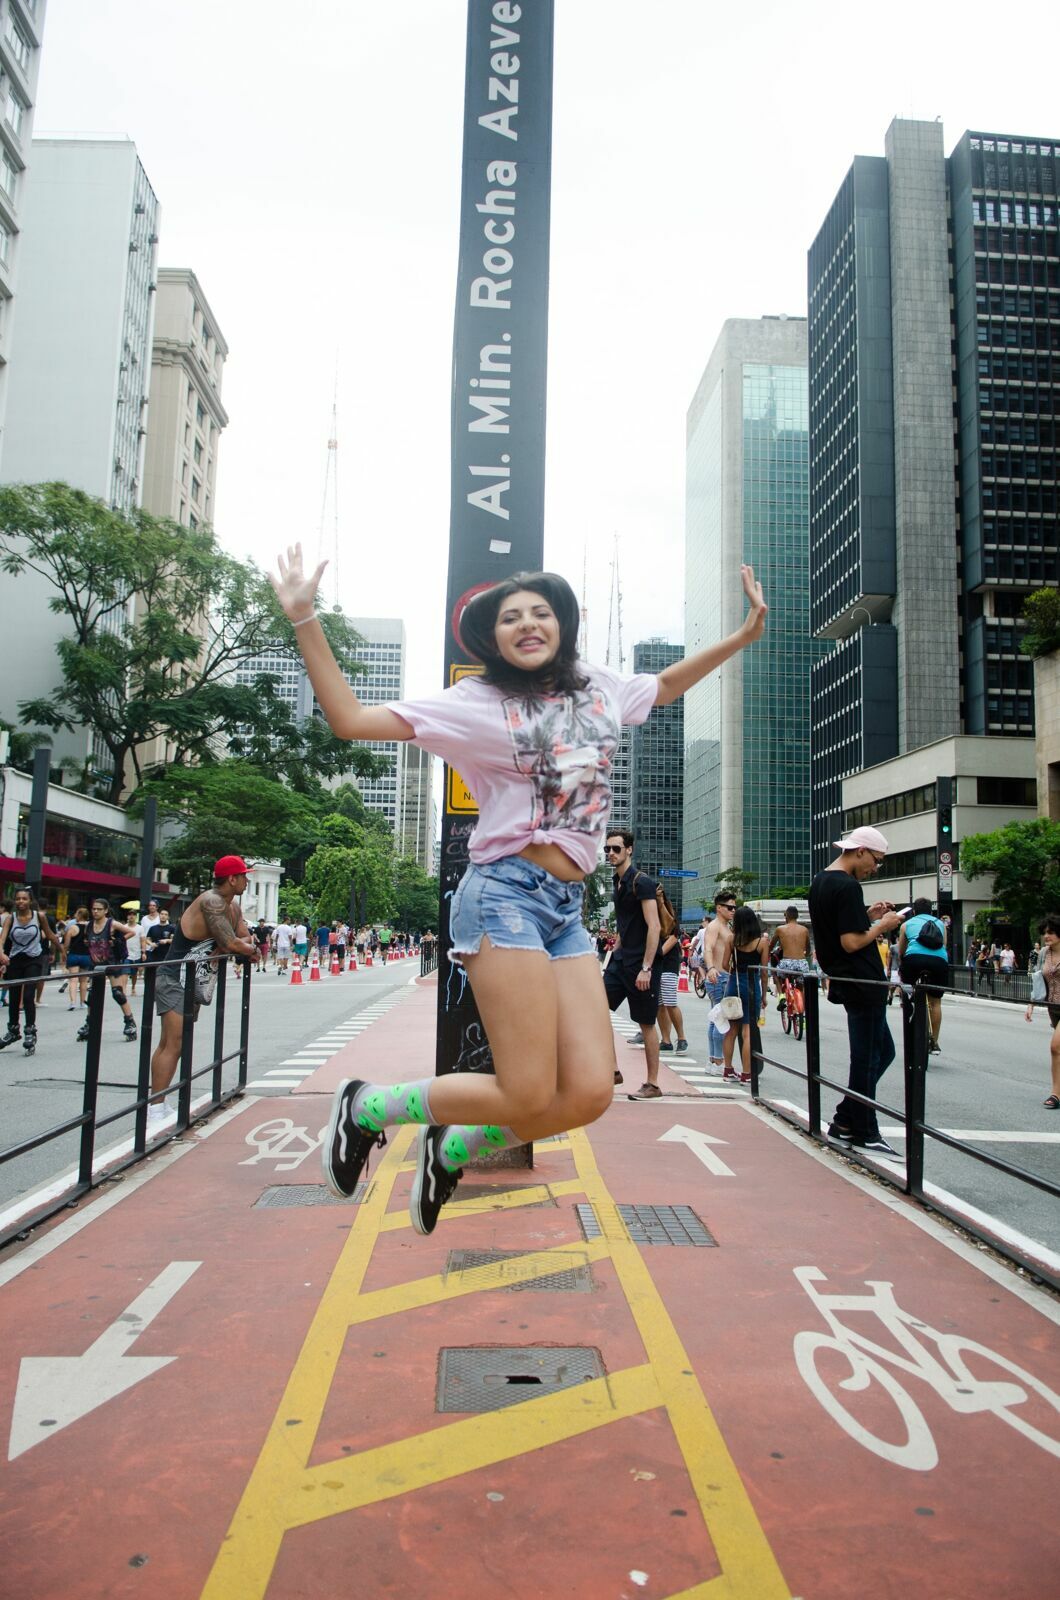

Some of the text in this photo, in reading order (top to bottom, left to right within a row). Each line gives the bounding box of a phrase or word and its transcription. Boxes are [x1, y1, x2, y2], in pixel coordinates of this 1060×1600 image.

[467, 0, 522, 521] Al. Min. Rocha Azeve
